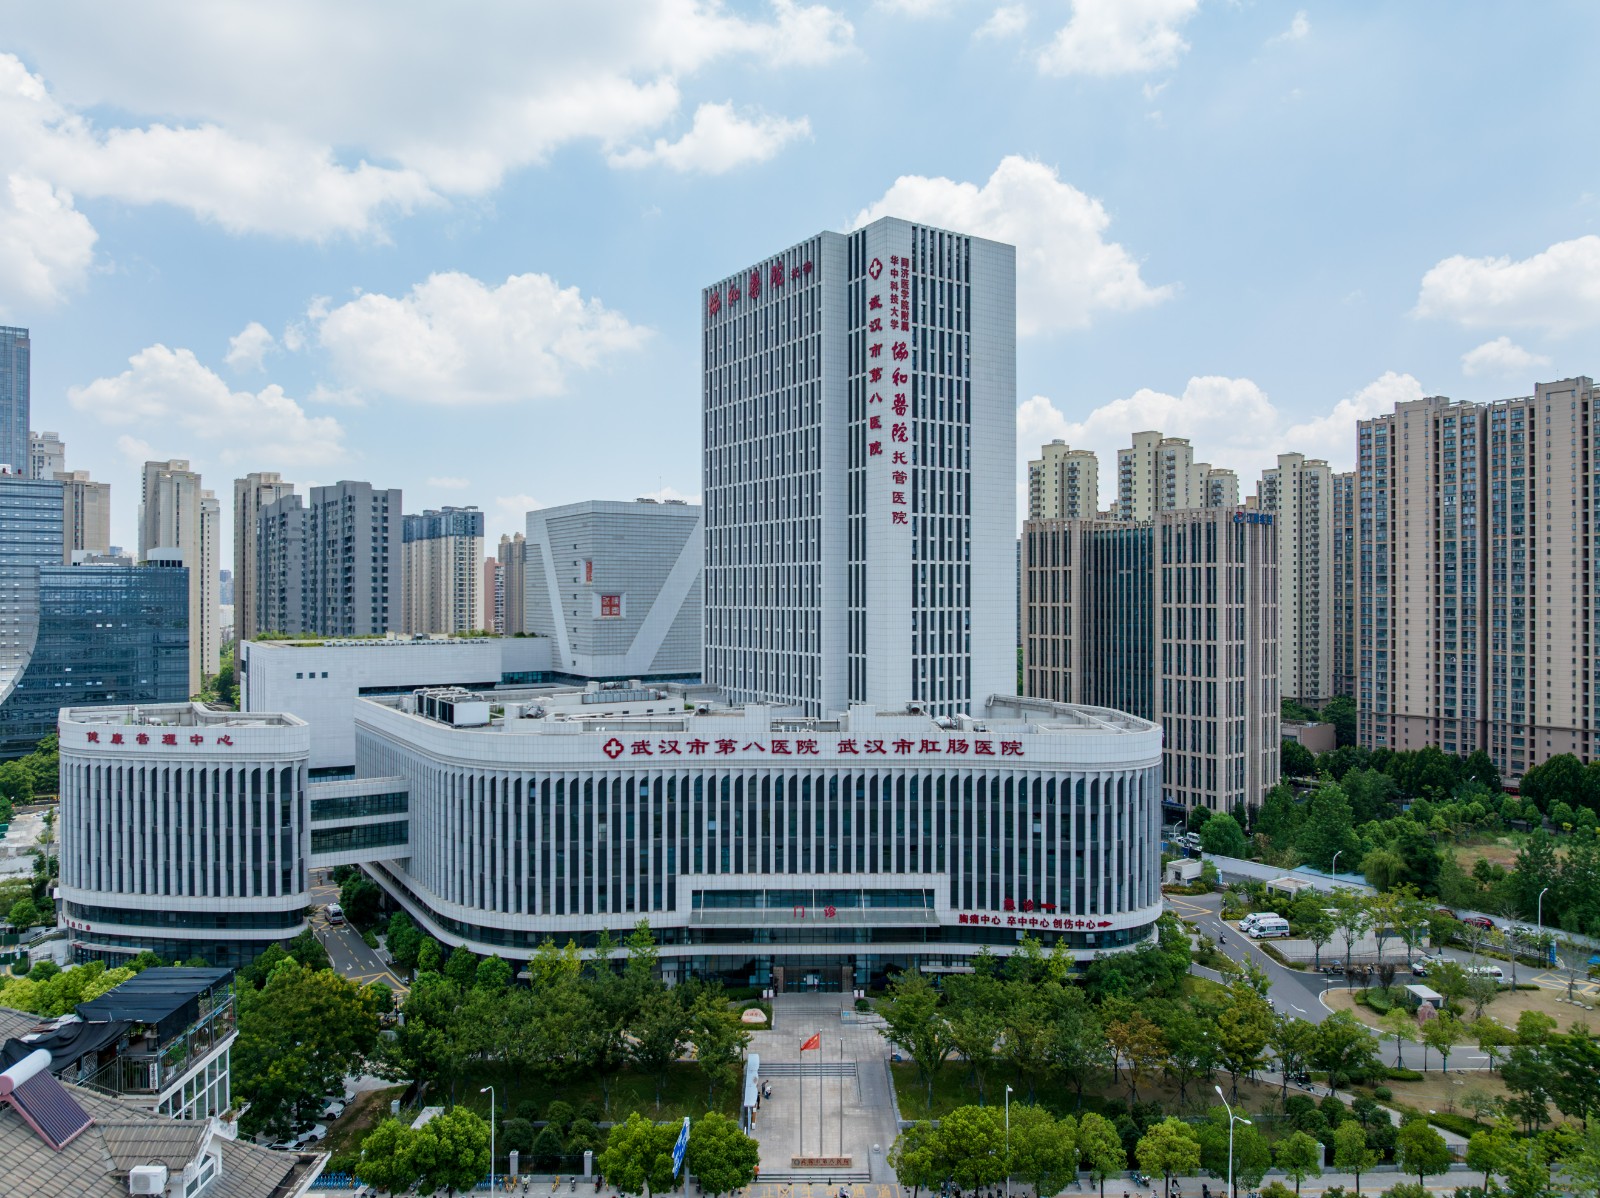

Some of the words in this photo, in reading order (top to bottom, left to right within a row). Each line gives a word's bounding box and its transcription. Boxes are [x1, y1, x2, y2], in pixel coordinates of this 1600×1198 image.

[890, 254, 899, 330] 华中科技大学
[869, 294, 883, 457] 武汉市第八医院
[86, 731, 234, 746] 健康管理中心
[631, 738, 820, 755] 武汉市第八医院
[837, 738, 1025, 756] 武汉市肛肠医院
[793, 905, 837, 918] 门诊
[1003, 897, 1035, 912] 急诊
[958, 914, 1001, 925] 胸痛中心
[1007, 916, 1050, 928] 卒中中心
[1052, 918, 1096, 930] 创伤中心
